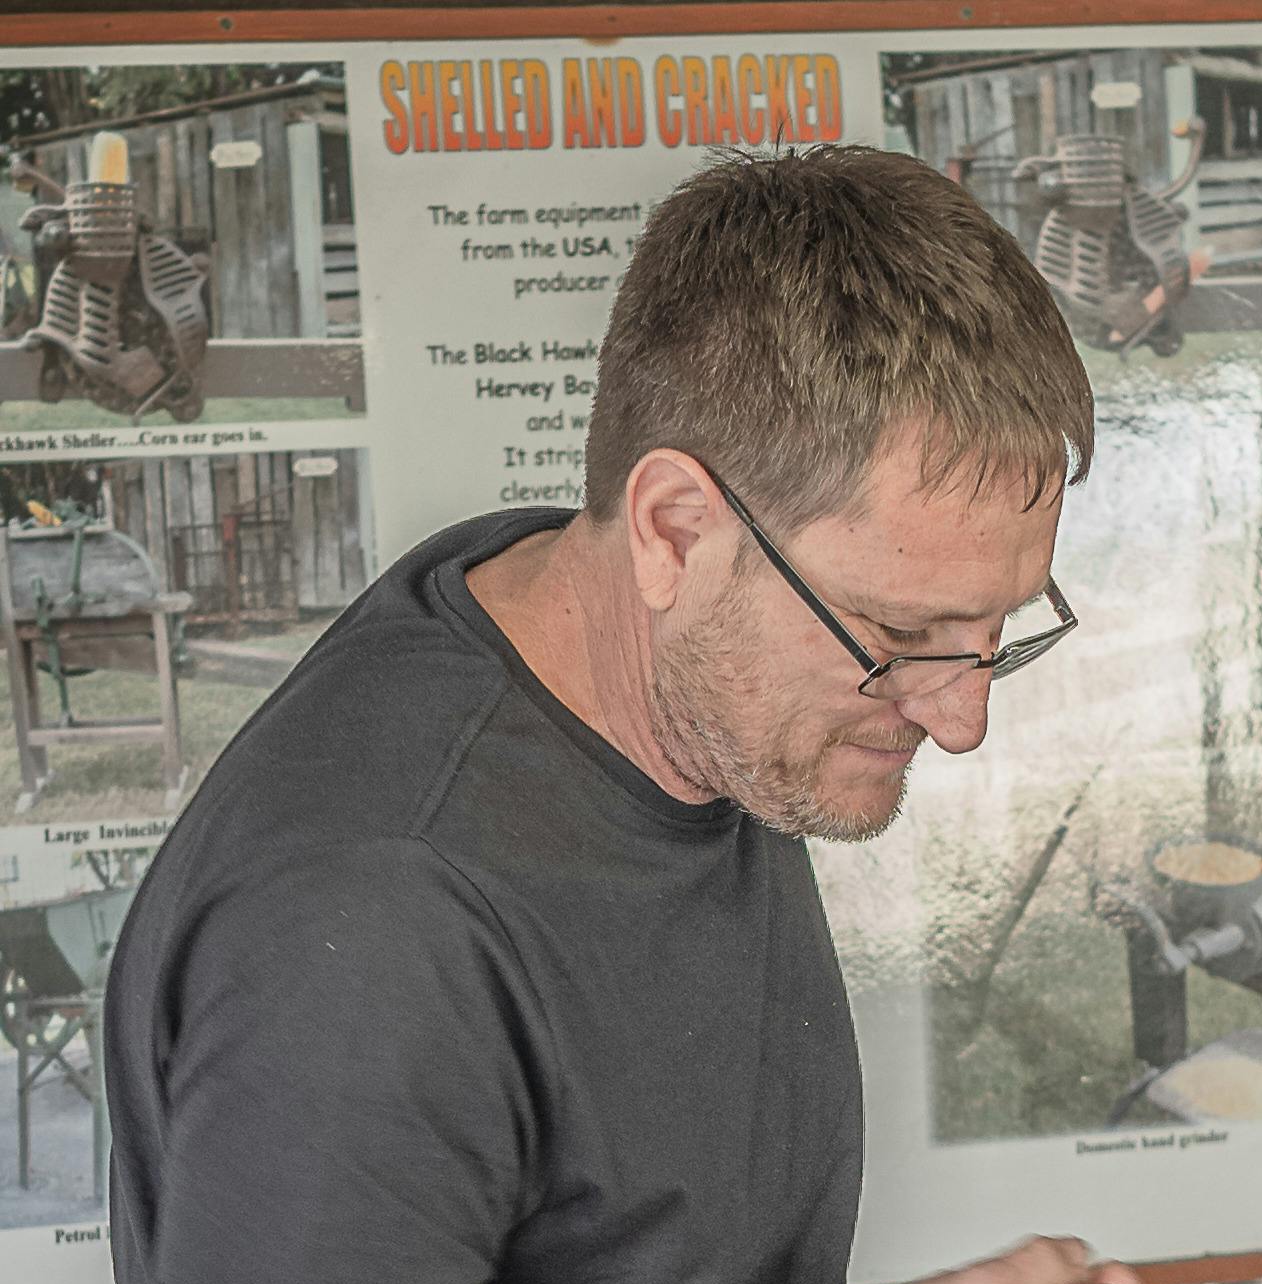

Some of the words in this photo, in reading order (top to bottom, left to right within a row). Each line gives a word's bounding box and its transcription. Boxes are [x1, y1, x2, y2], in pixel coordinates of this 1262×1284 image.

[379, 57, 553, 155] SHELLED
[562, 56, 646, 149] AND
[653, 52, 844, 148] CRACKED
[427, 205, 469, 226] The
[477, 203, 528, 225] farm
[535, 202, 641, 228] equipment
[461, 239, 514, 262] from
[520, 238, 556, 259] the
[514, 269, 610, 299] producer
[427, 344, 467, 365] The
[474, 341, 532, 364] Black
[476, 377, 554, 402] Hervey
[527, 409, 565, 432] and
[503, 446, 527, 467] It
[44, 827, 90, 845] Large
